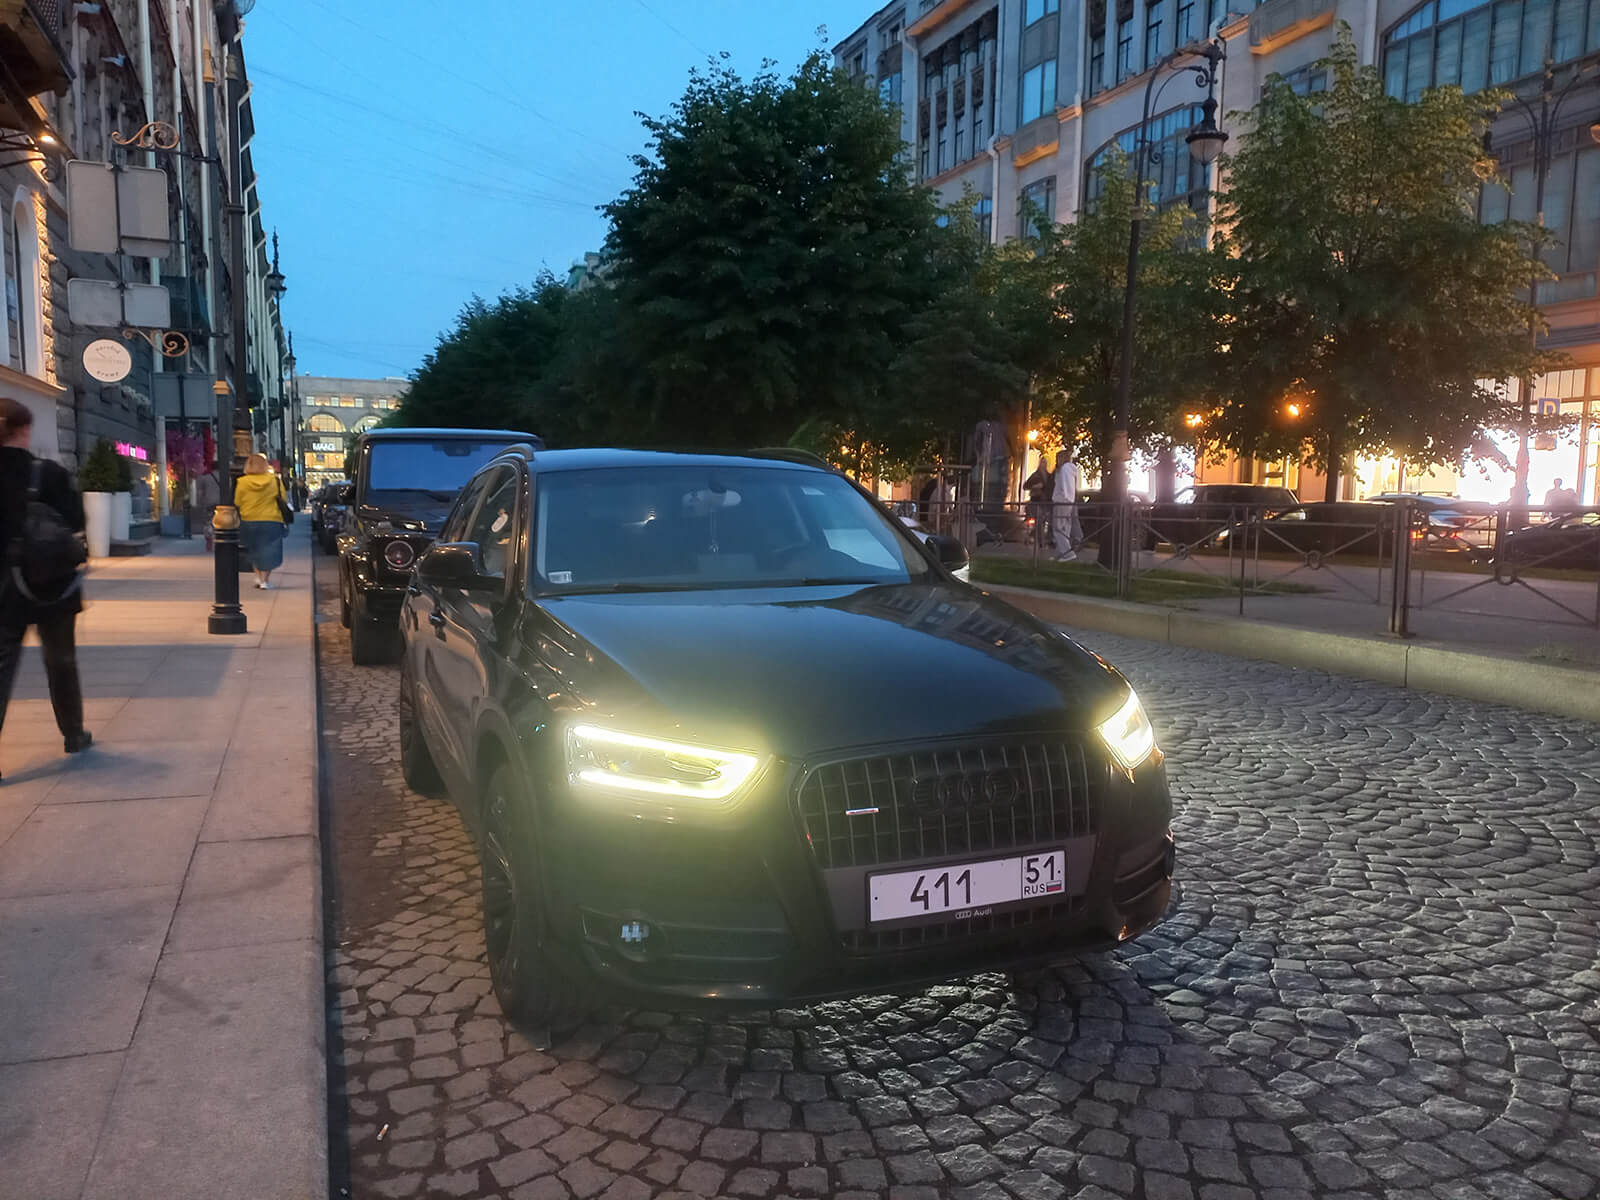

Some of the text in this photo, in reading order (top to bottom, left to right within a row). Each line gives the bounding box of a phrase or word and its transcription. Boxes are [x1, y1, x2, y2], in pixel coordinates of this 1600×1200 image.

[910, 855, 1055, 910] 411 51
[1024, 883, 1046, 896] RUS
[973, 907, 992, 917] Audi
